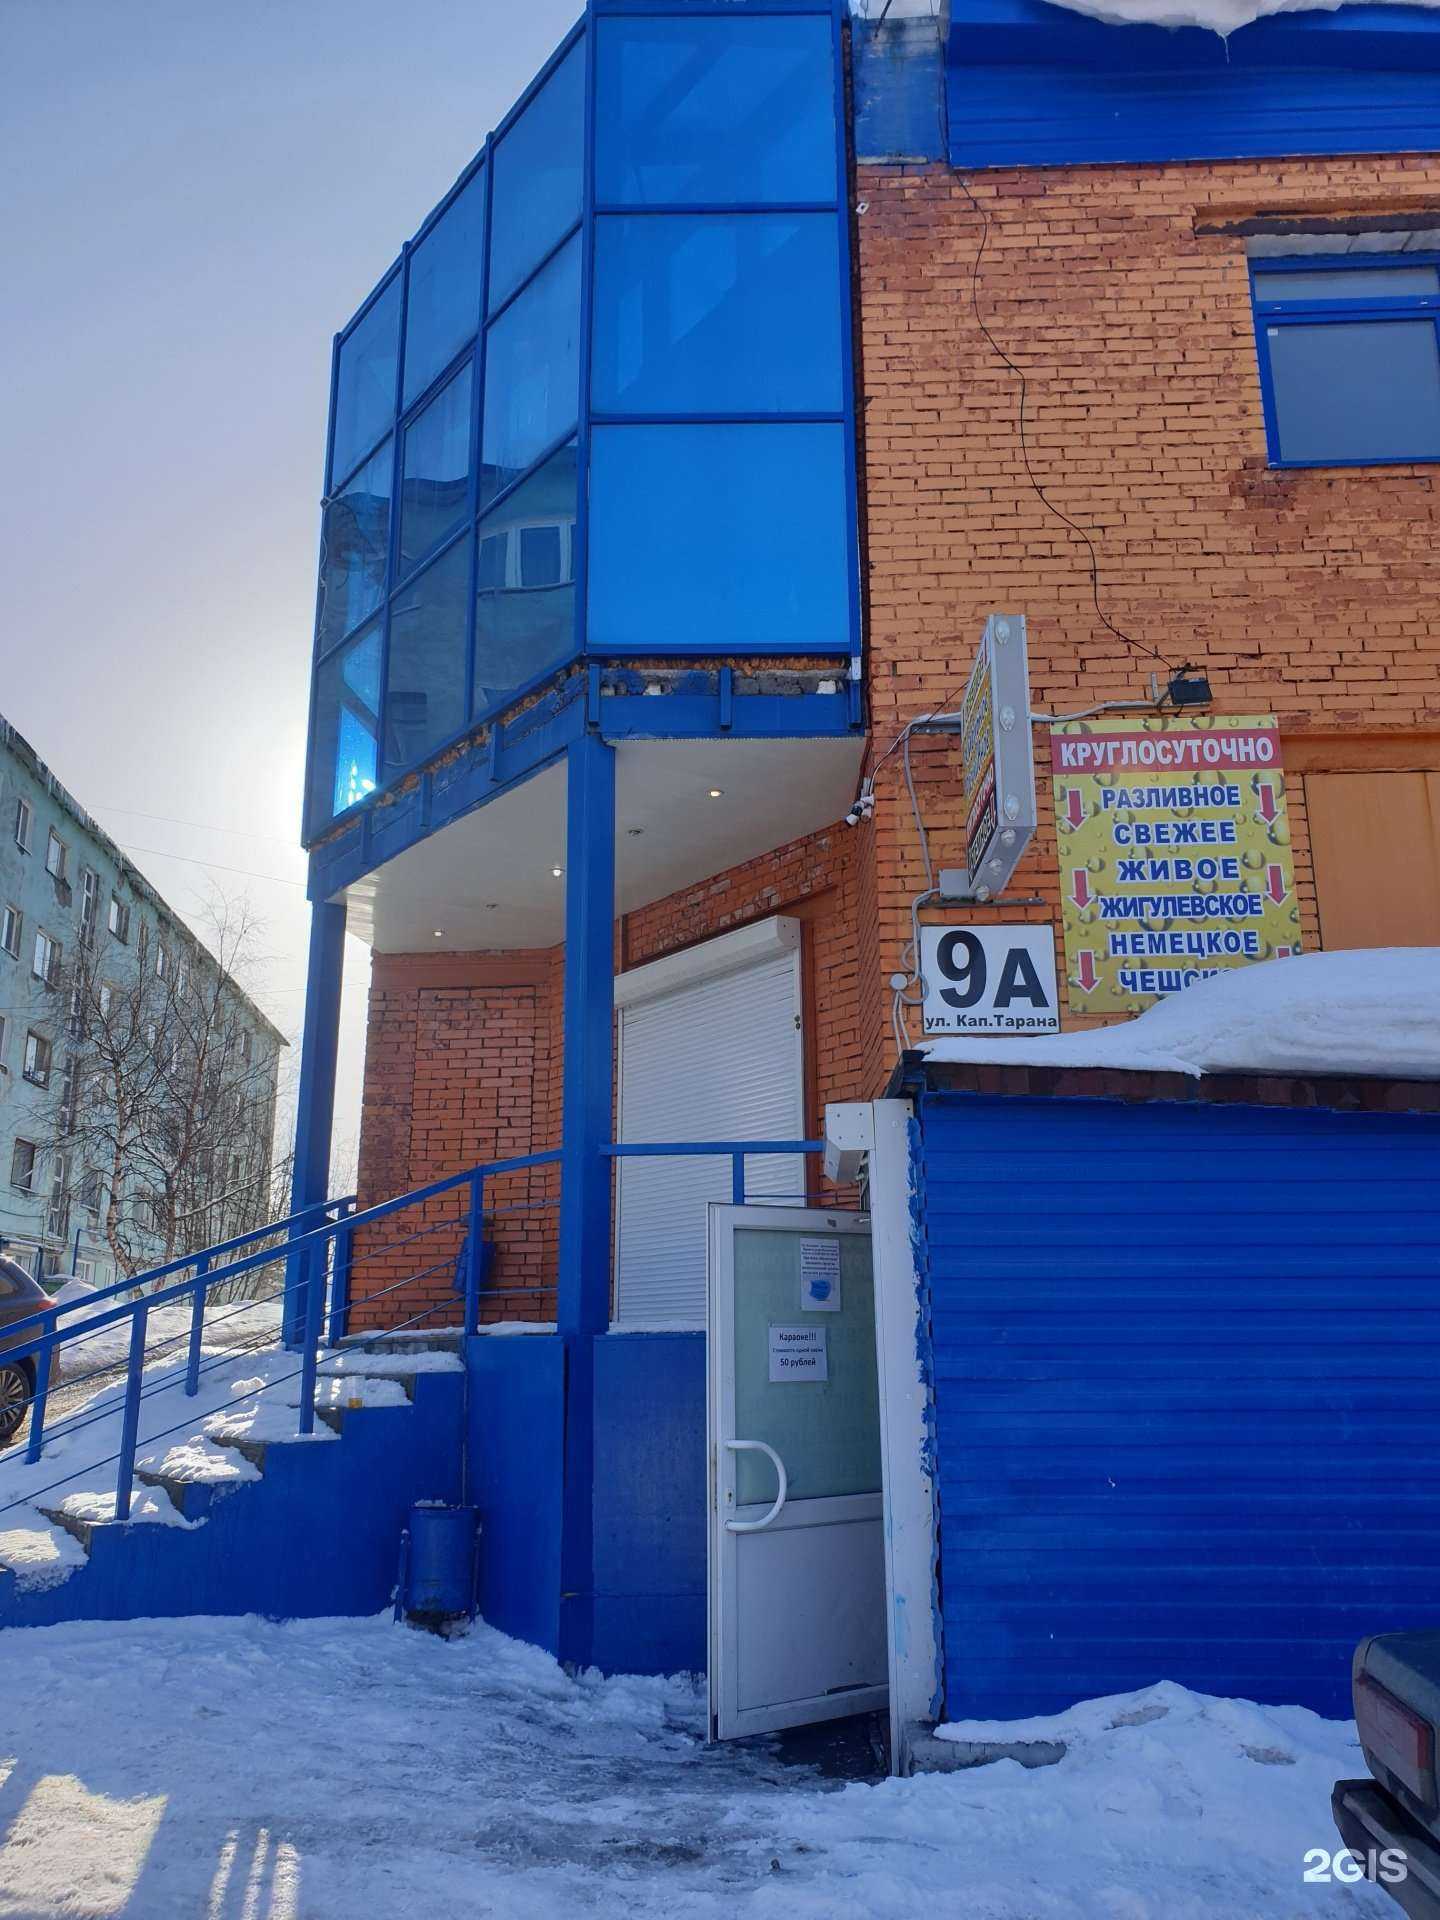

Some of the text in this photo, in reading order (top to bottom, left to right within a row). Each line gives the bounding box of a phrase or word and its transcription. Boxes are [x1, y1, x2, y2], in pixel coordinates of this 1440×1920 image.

[1061, 736, 1274, 767] КРУГЛОСУТОЧНО
[1102, 785, 1241, 809] РАЗЛИВНОЕ
[1114, 821, 1236, 845] СВЕЖЕЕ
[1118, 858, 1240, 881] ЖИВОЕ
[1100, 894, 1263, 918] ЖИГУЛЕВСКОЕ
[1111, 931, 1259, 957] НЕМЕЦКОЕ
[1119, 969, 1233, 993] ЧЕШС
[925, 1016, 950, 1030] ул.
[779, 1332, 817, 1342] Караоке!!!
[780, 1357, 816, 1368] 50 рублей
